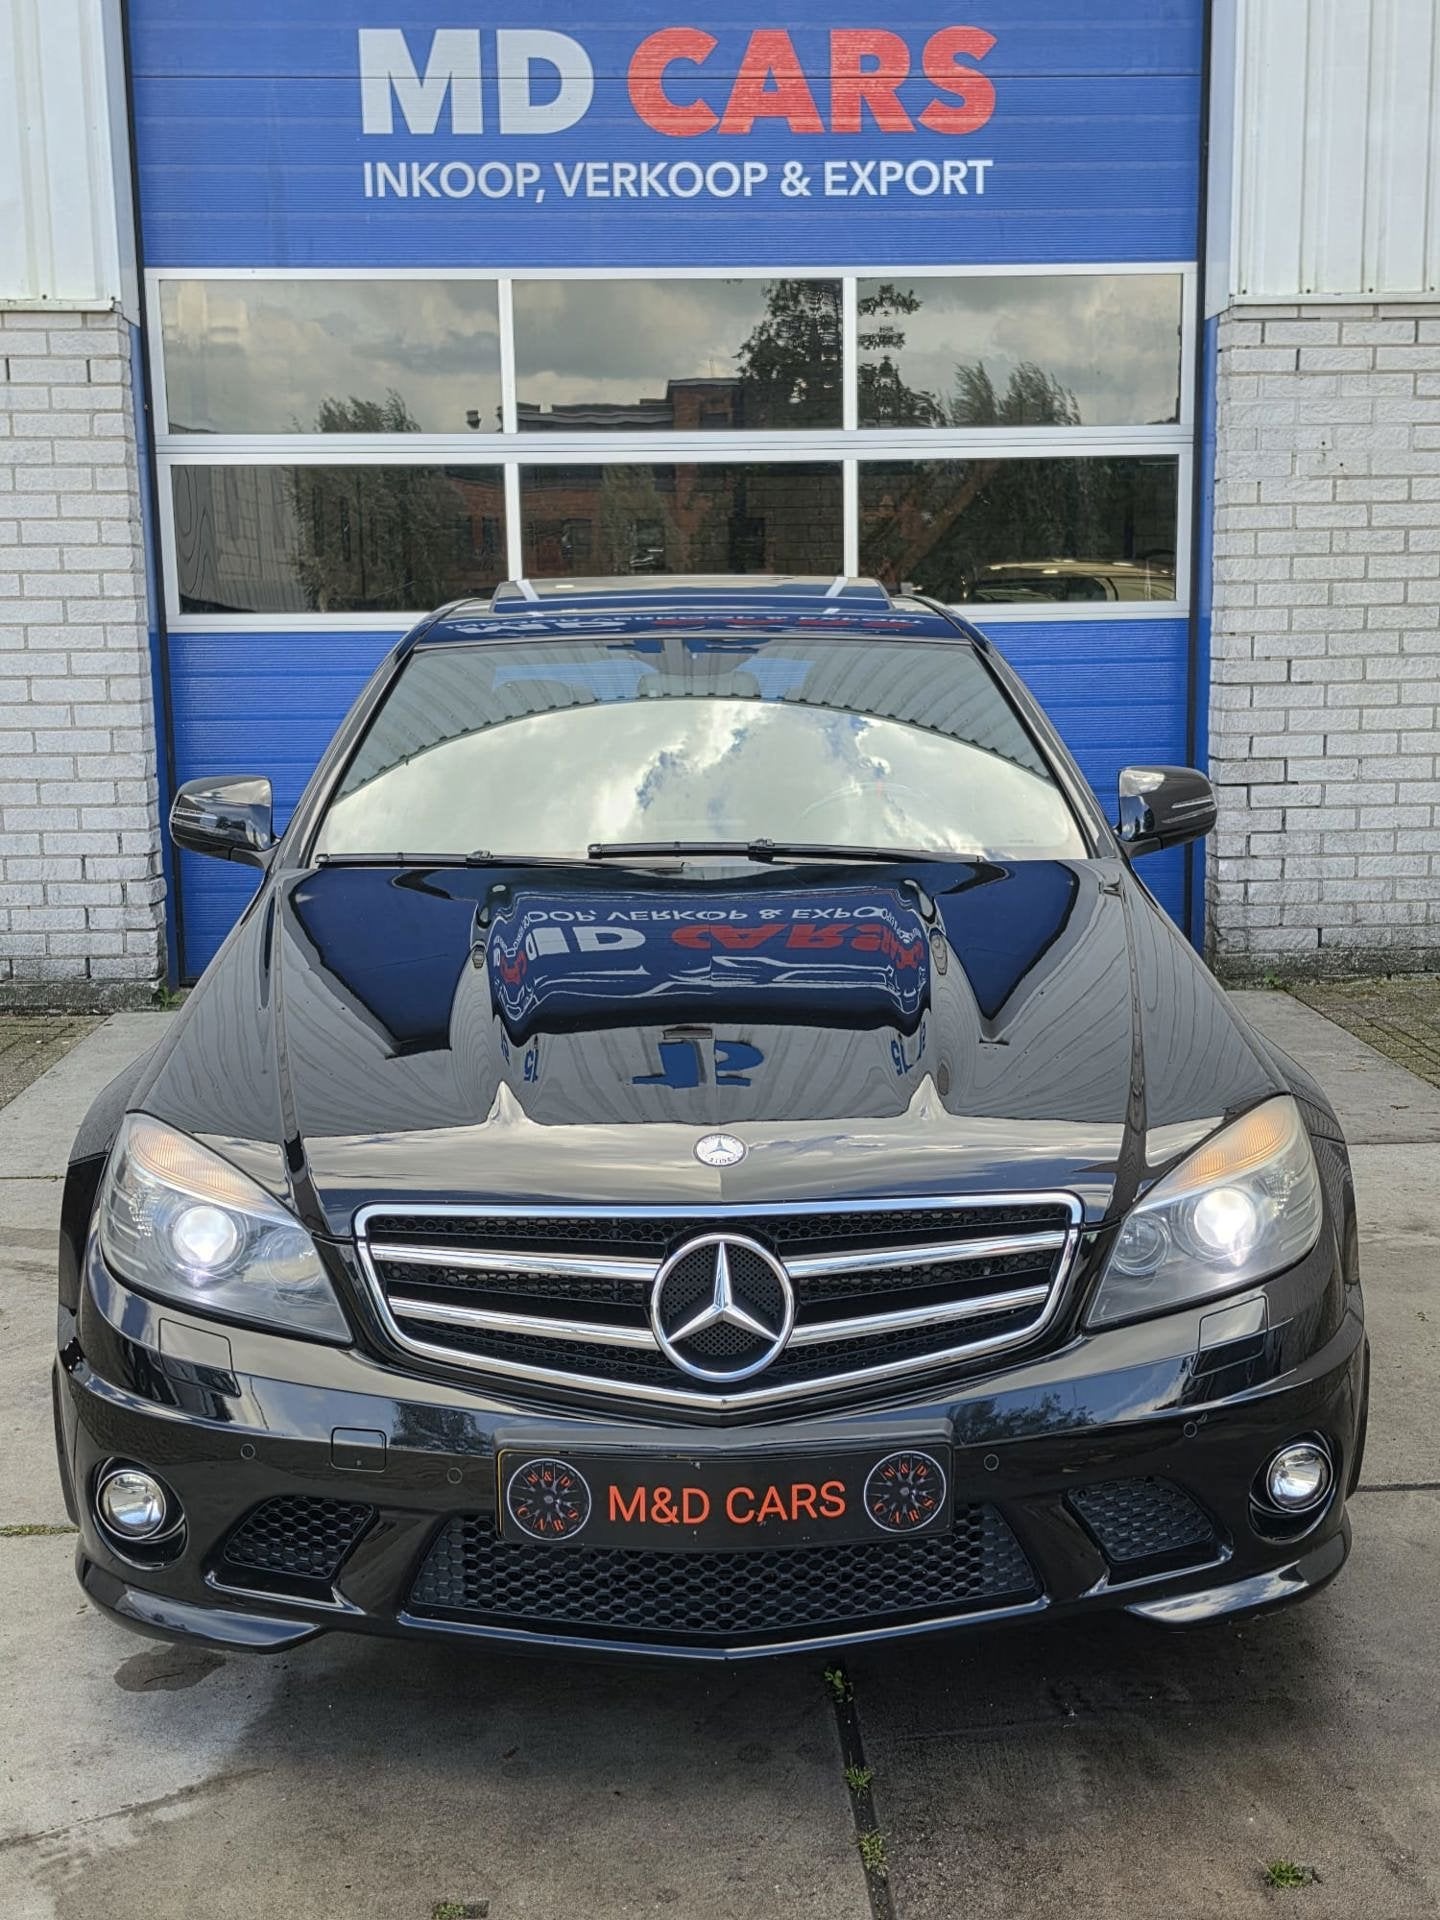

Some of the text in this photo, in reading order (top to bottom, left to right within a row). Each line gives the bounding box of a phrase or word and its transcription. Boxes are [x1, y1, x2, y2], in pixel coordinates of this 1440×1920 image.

[358, 25, 998, 138] MD CARS
[363, 159, 994, 204] INKOOP, VERKOOP & EXPORT
[608, 1480, 847, 1526] M&D CARS
